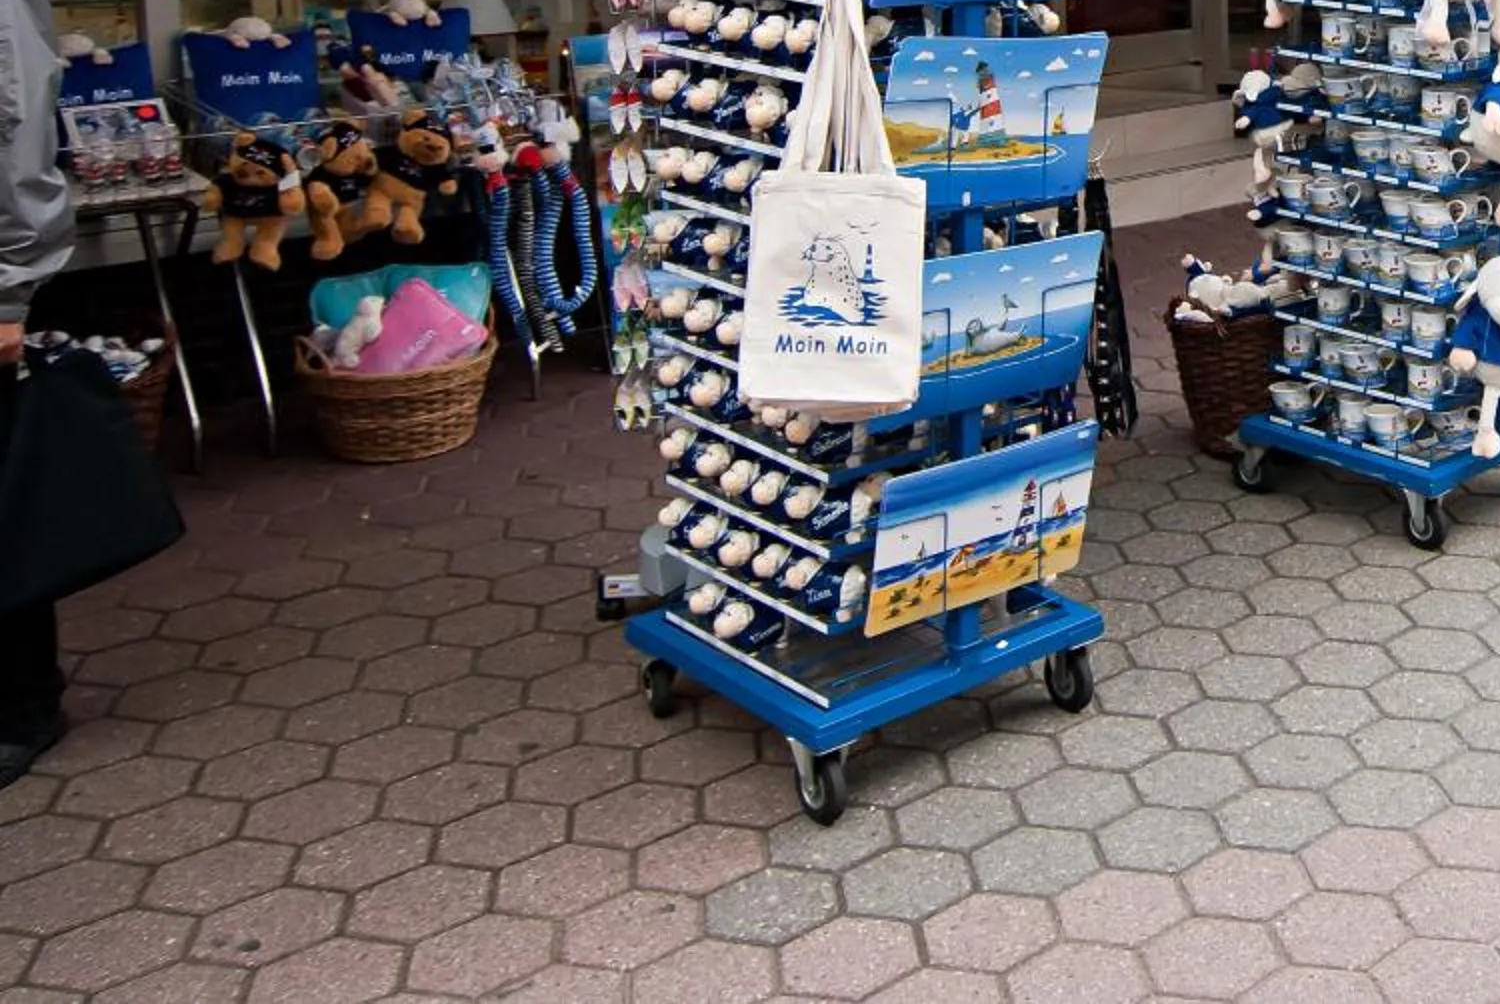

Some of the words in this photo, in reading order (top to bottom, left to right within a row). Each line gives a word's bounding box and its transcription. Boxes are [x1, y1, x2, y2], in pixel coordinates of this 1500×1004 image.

[380, 52, 414, 66] Moin
[221, 73, 259, 88] Moin
[268, 70, 303, 85] Moin
[56, 92, 84, 108] oin
[775, 334, 826, 355] Moin
[836, 334, 888, 355] Moin
